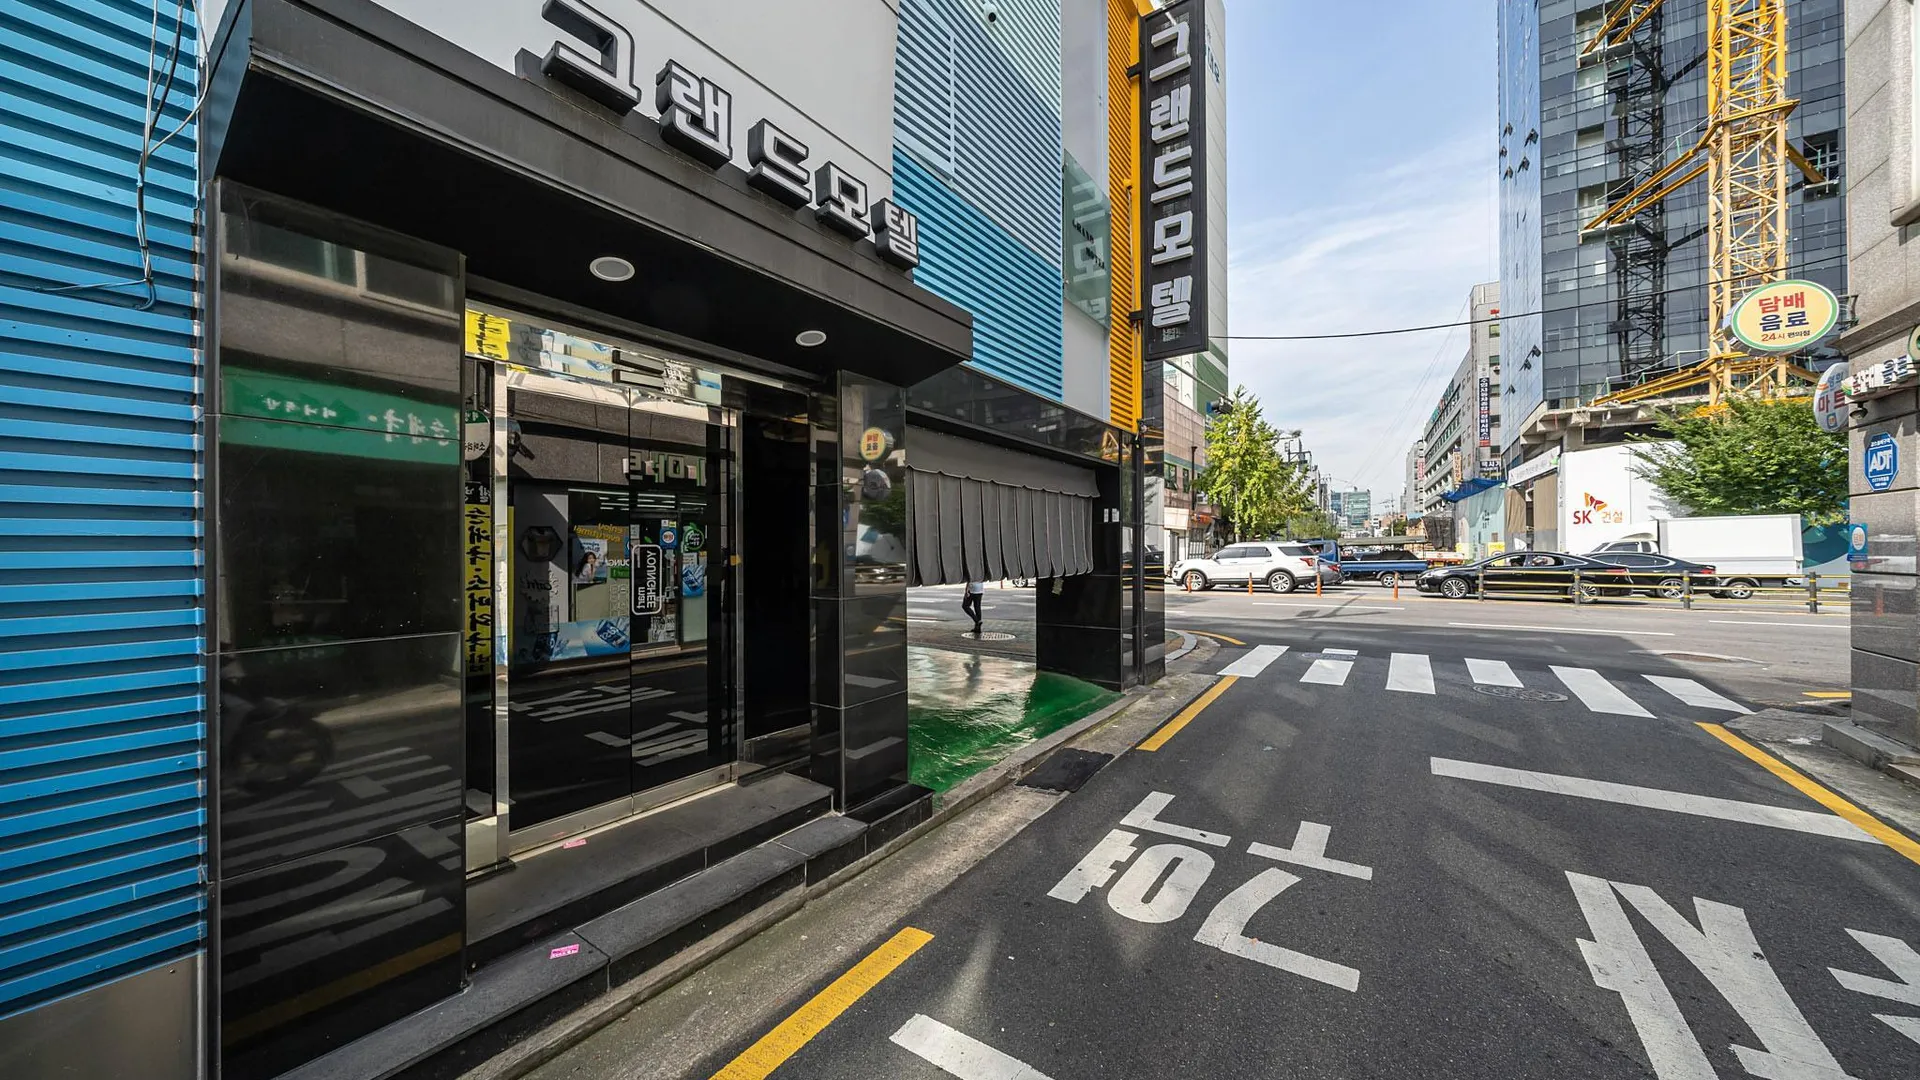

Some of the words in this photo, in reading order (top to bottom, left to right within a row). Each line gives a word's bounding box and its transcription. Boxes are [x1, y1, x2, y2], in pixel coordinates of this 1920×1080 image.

[540, 0, 920, 271] 그랜드모텔
[1149, 21, 1194, 329] 그랜드모텔
[1758, 291, 1805, 314] 담배
[1758, 310, 1809, 332] 음료
[1761, 332, 1785, 342] 24시
[1787, 329, 1811, 339] 편의점
[1818, 389, 1847, 413] 마트
[1869, 449, 1893, 473] ADT
[1573, 510, 1592, 525] SK
[1601, 511, 1623, 524] 건설
